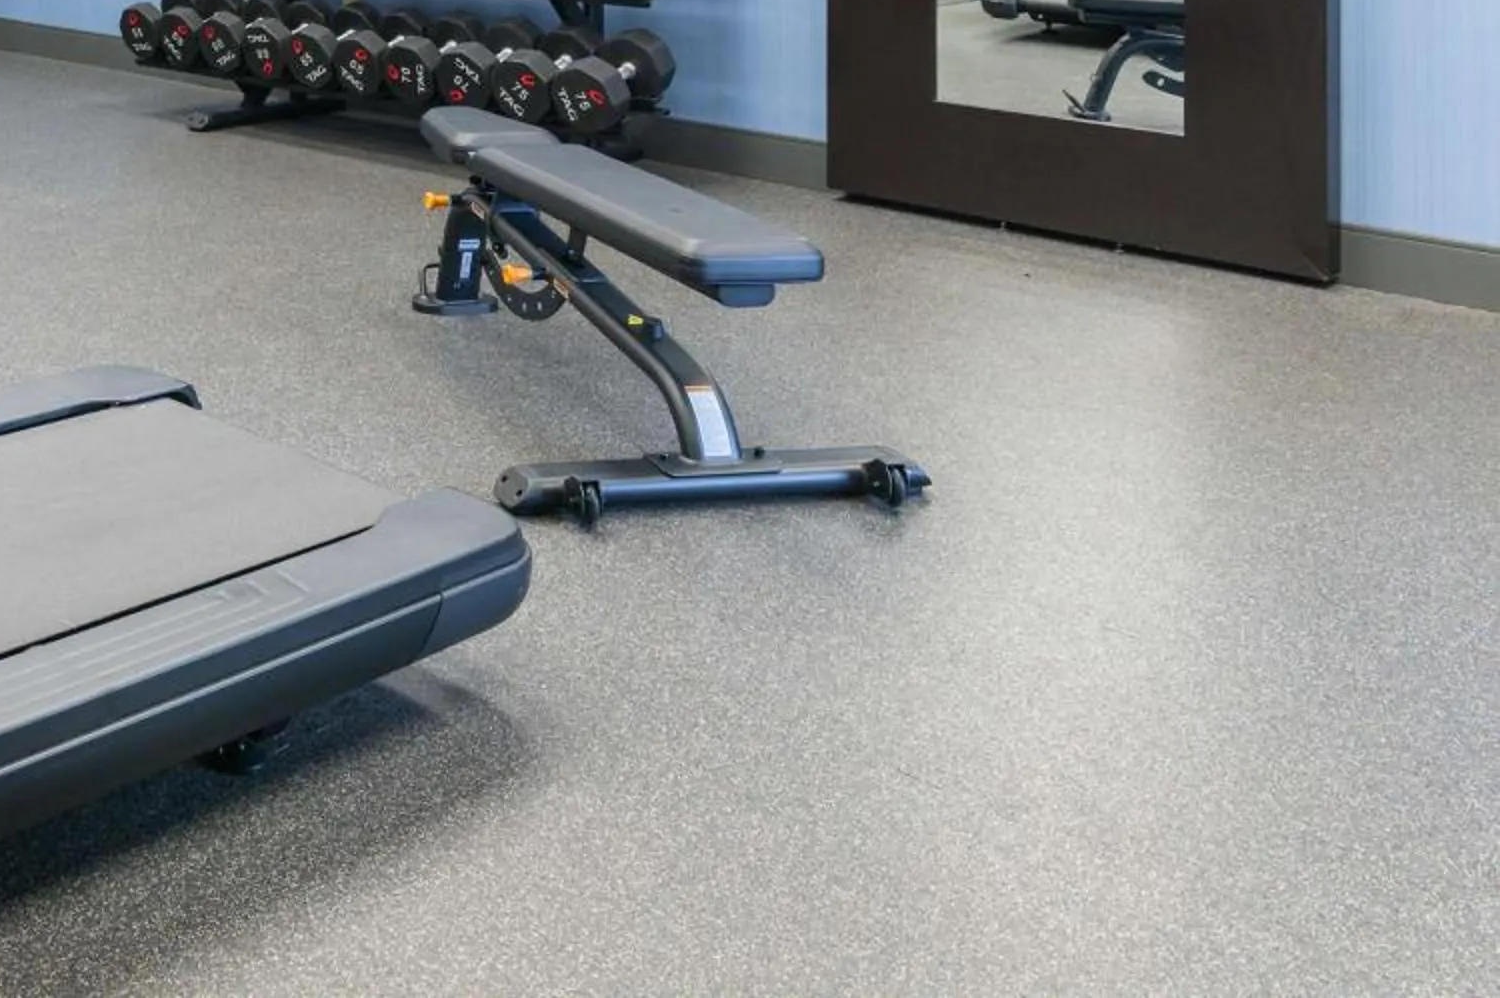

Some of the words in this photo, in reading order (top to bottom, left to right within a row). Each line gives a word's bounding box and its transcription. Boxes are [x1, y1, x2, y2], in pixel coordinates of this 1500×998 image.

[246, 34, 270, 44] TAG
[305, 65, 328, 83] TAG
[340, 65, 364, 92] TAG
[401, 67, 412, 83] 70
[415, 63, 426, 94] TAG
[452, 57, 482, 86] TAG
[500, 86, 525, 118] TAG
[512, 82, 530, 101] 75
[575, 90, 592, 112] 75
[558, 86, 578, 122] TAG
